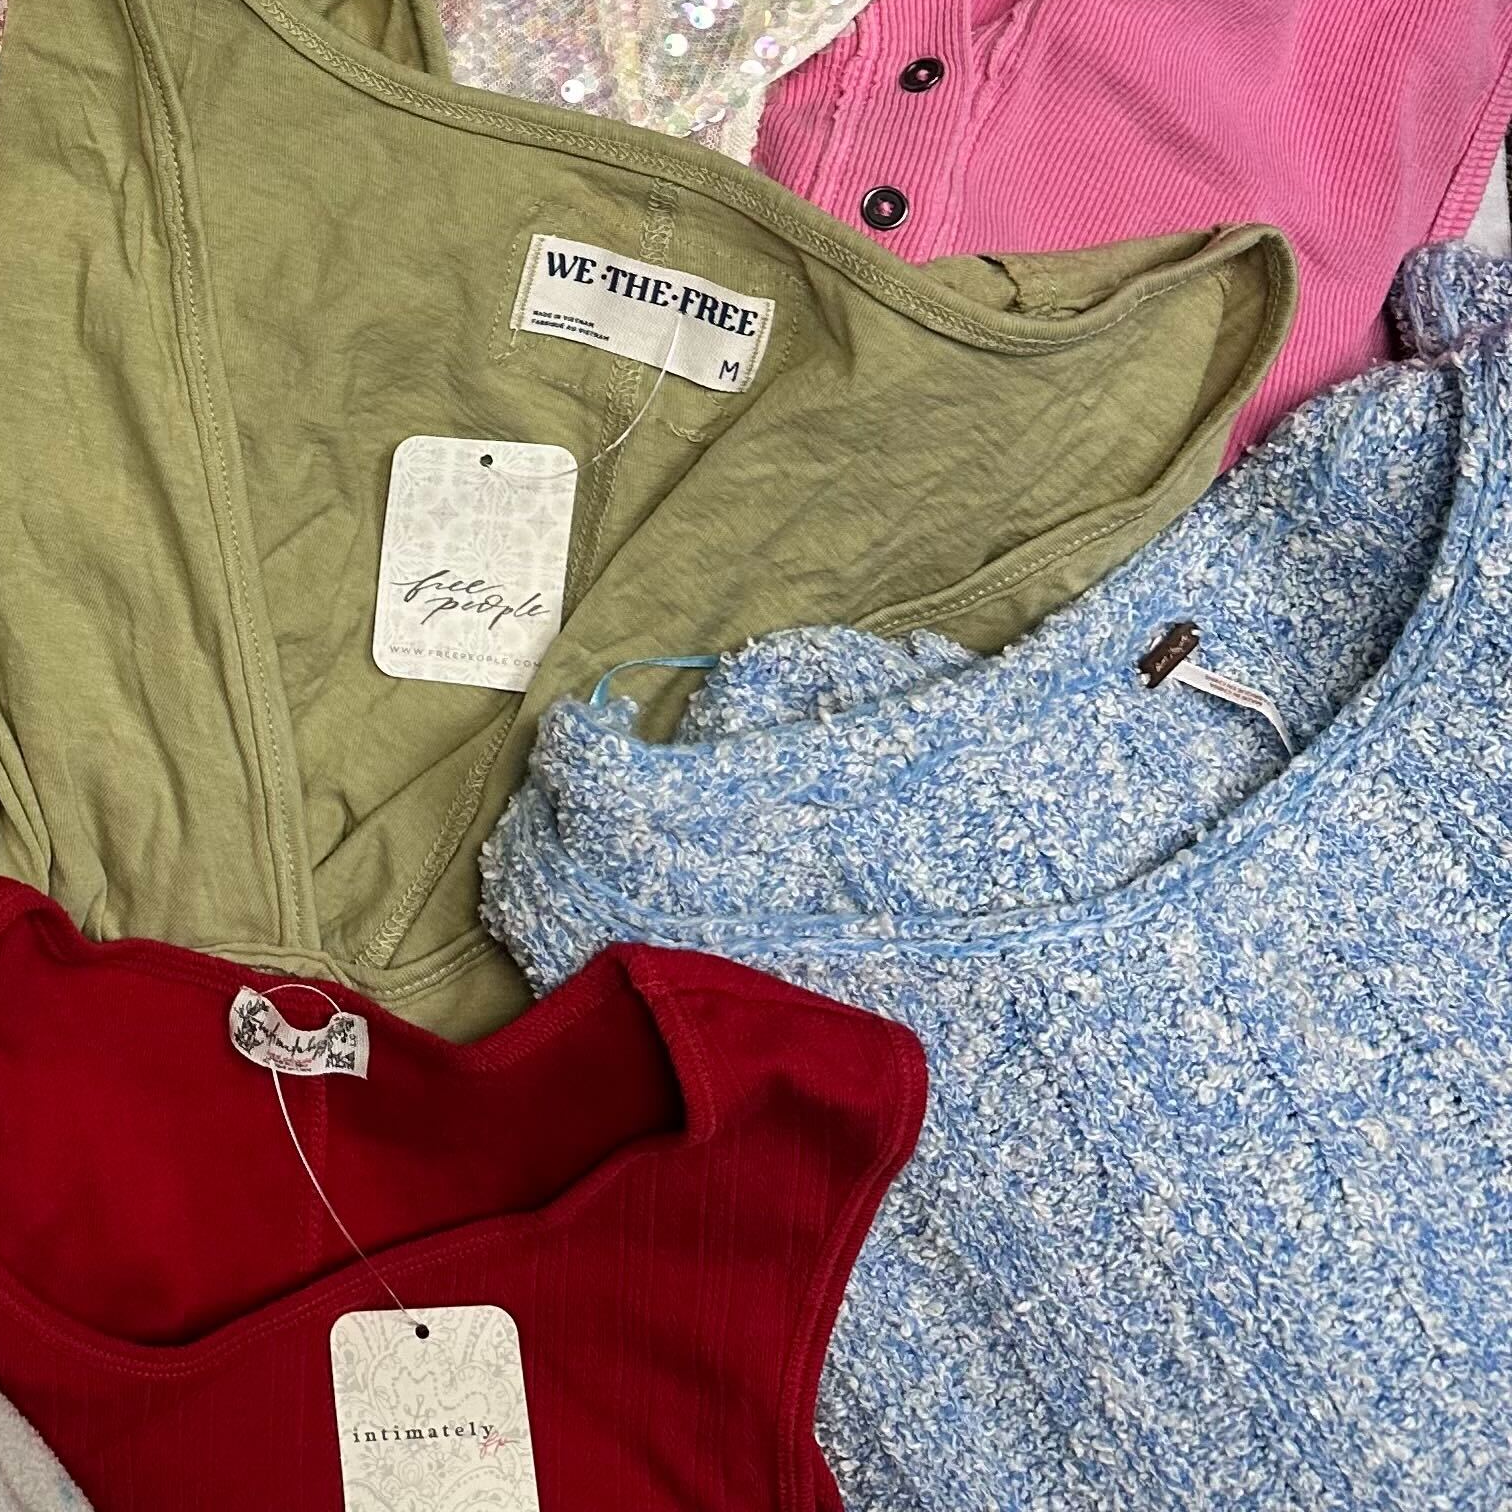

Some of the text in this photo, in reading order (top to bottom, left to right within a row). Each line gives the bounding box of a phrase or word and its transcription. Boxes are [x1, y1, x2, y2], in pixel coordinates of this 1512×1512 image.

[719, 360, 739, 382] M
[390, 569, 507, 603] free
[420, 592, 551, 630] people
[353, 1421, 494, 1443] intimately
